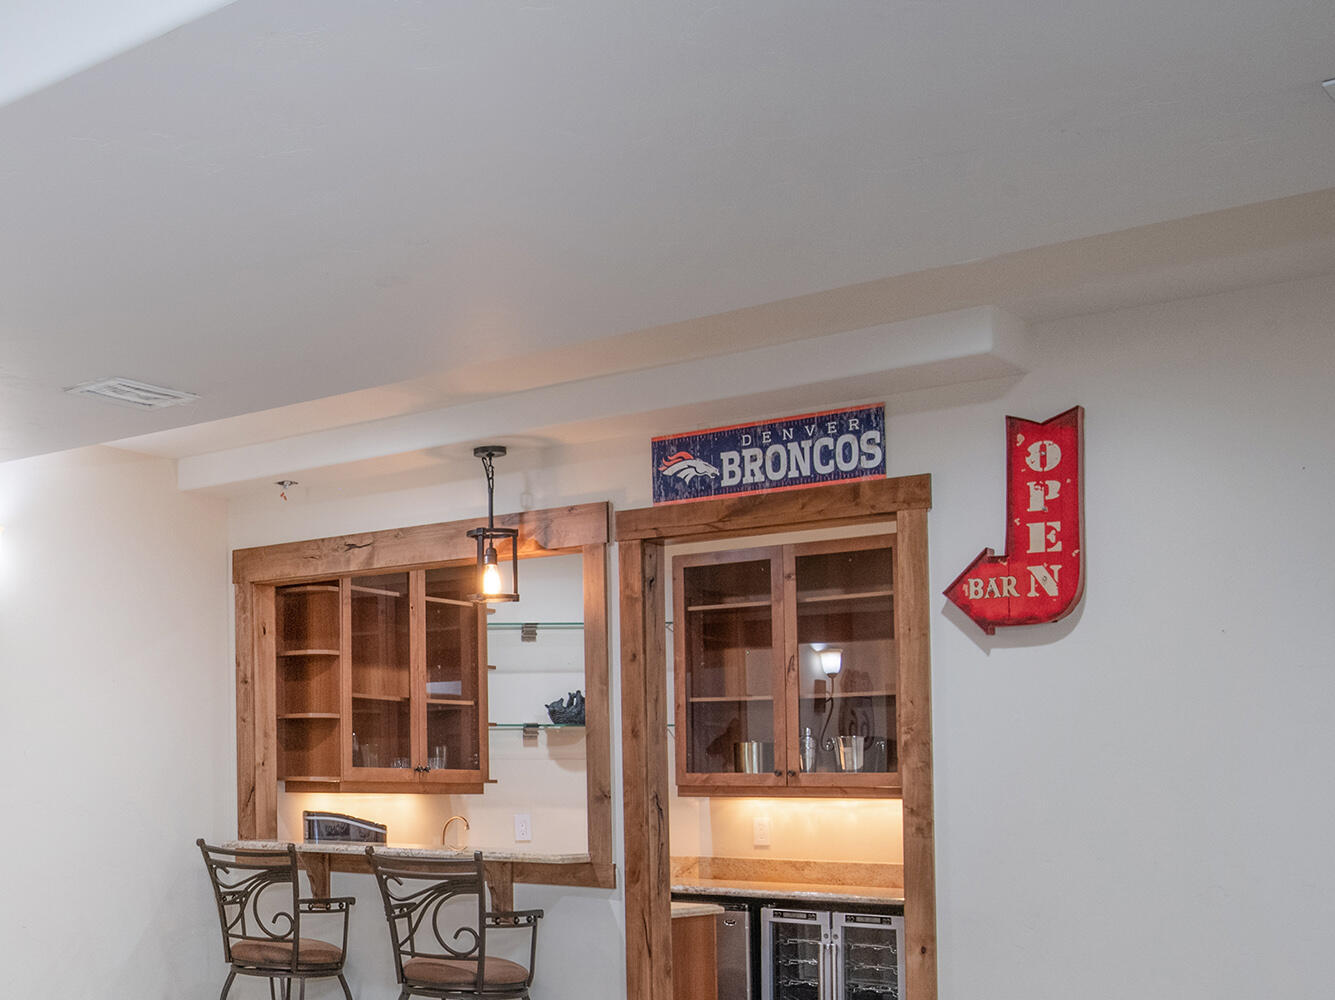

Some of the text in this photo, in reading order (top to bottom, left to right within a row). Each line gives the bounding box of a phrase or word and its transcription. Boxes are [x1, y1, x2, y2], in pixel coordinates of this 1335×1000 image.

[741, 418, 860, 447] DENVER
[720, 430, 883, 487] BRONCOS
[1025, 440, 1063, 598] OPEN
[967, 576, 1021, 600] BAR
